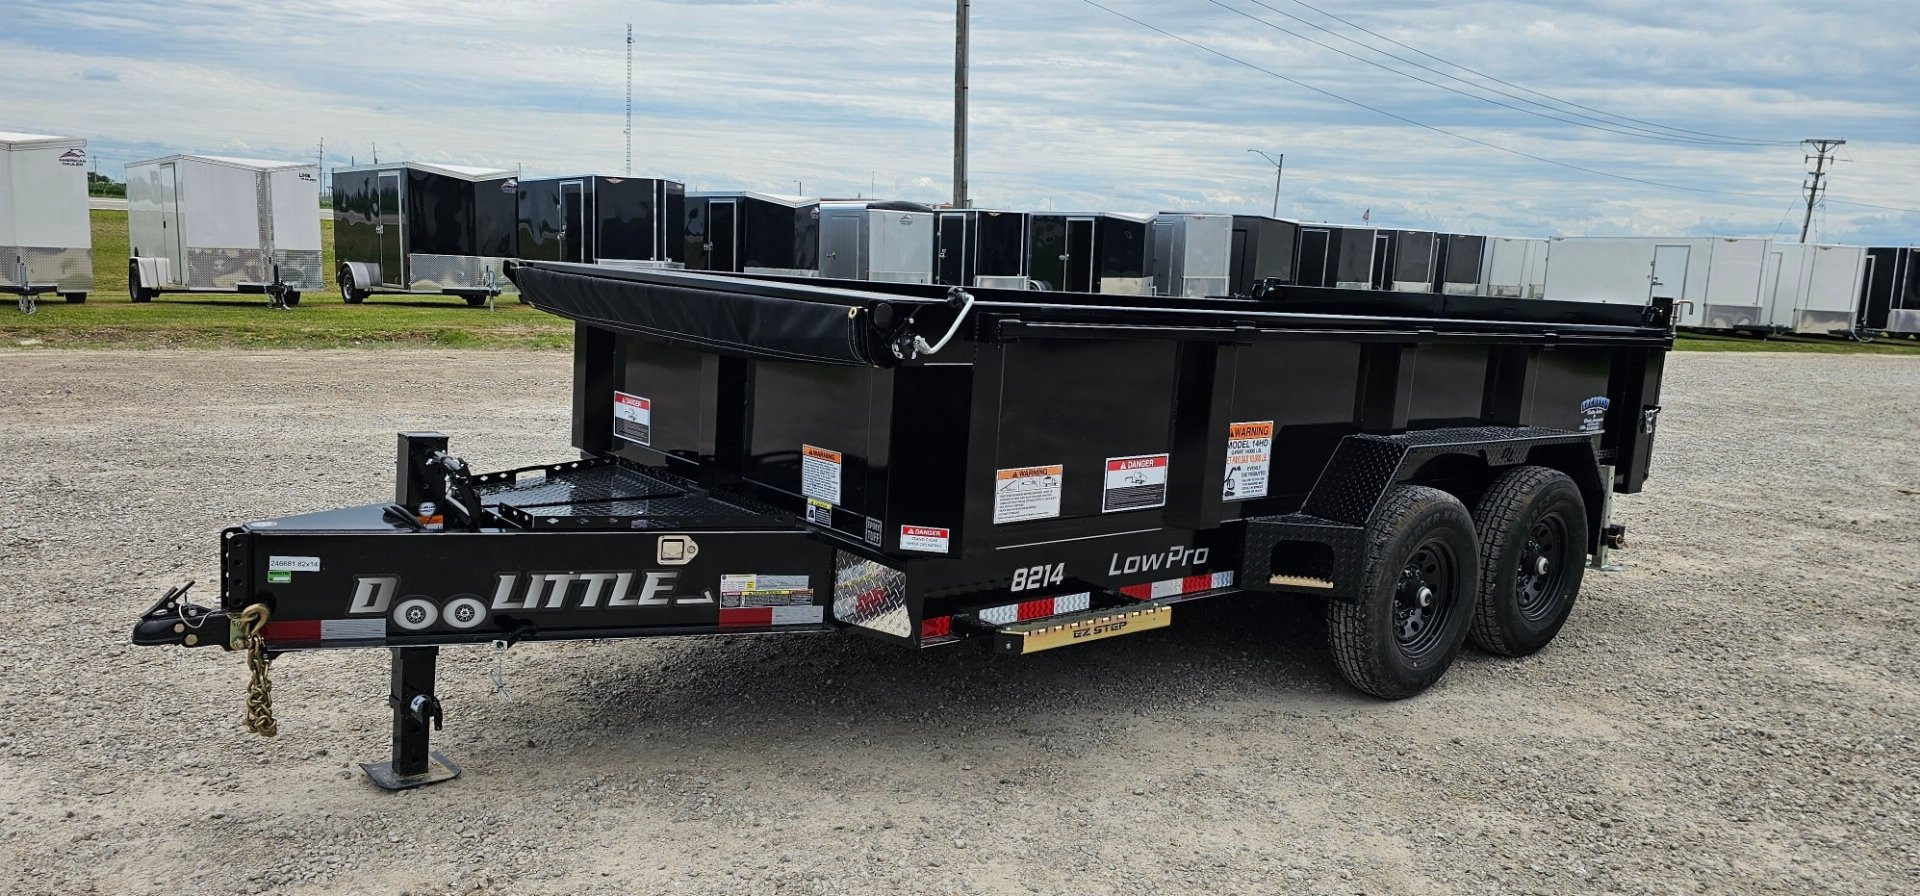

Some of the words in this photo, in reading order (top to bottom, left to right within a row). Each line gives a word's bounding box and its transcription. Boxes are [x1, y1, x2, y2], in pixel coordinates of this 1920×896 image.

[1234, 426, 1269, 437] WARNING
[813, 450, 836, 461] WARNING
[1127, 459, 1154, 469] DANGER
[1019, 468, 1048, 478] WARNING
[867, 529, 880, 543] TUFF
[914, 529, 941, 537] DANGER
[1010, 562, 1066, 592] 8214
[1072, 629, 1092, 639] EZ
[1092, 621, 1128, 636] STEP
